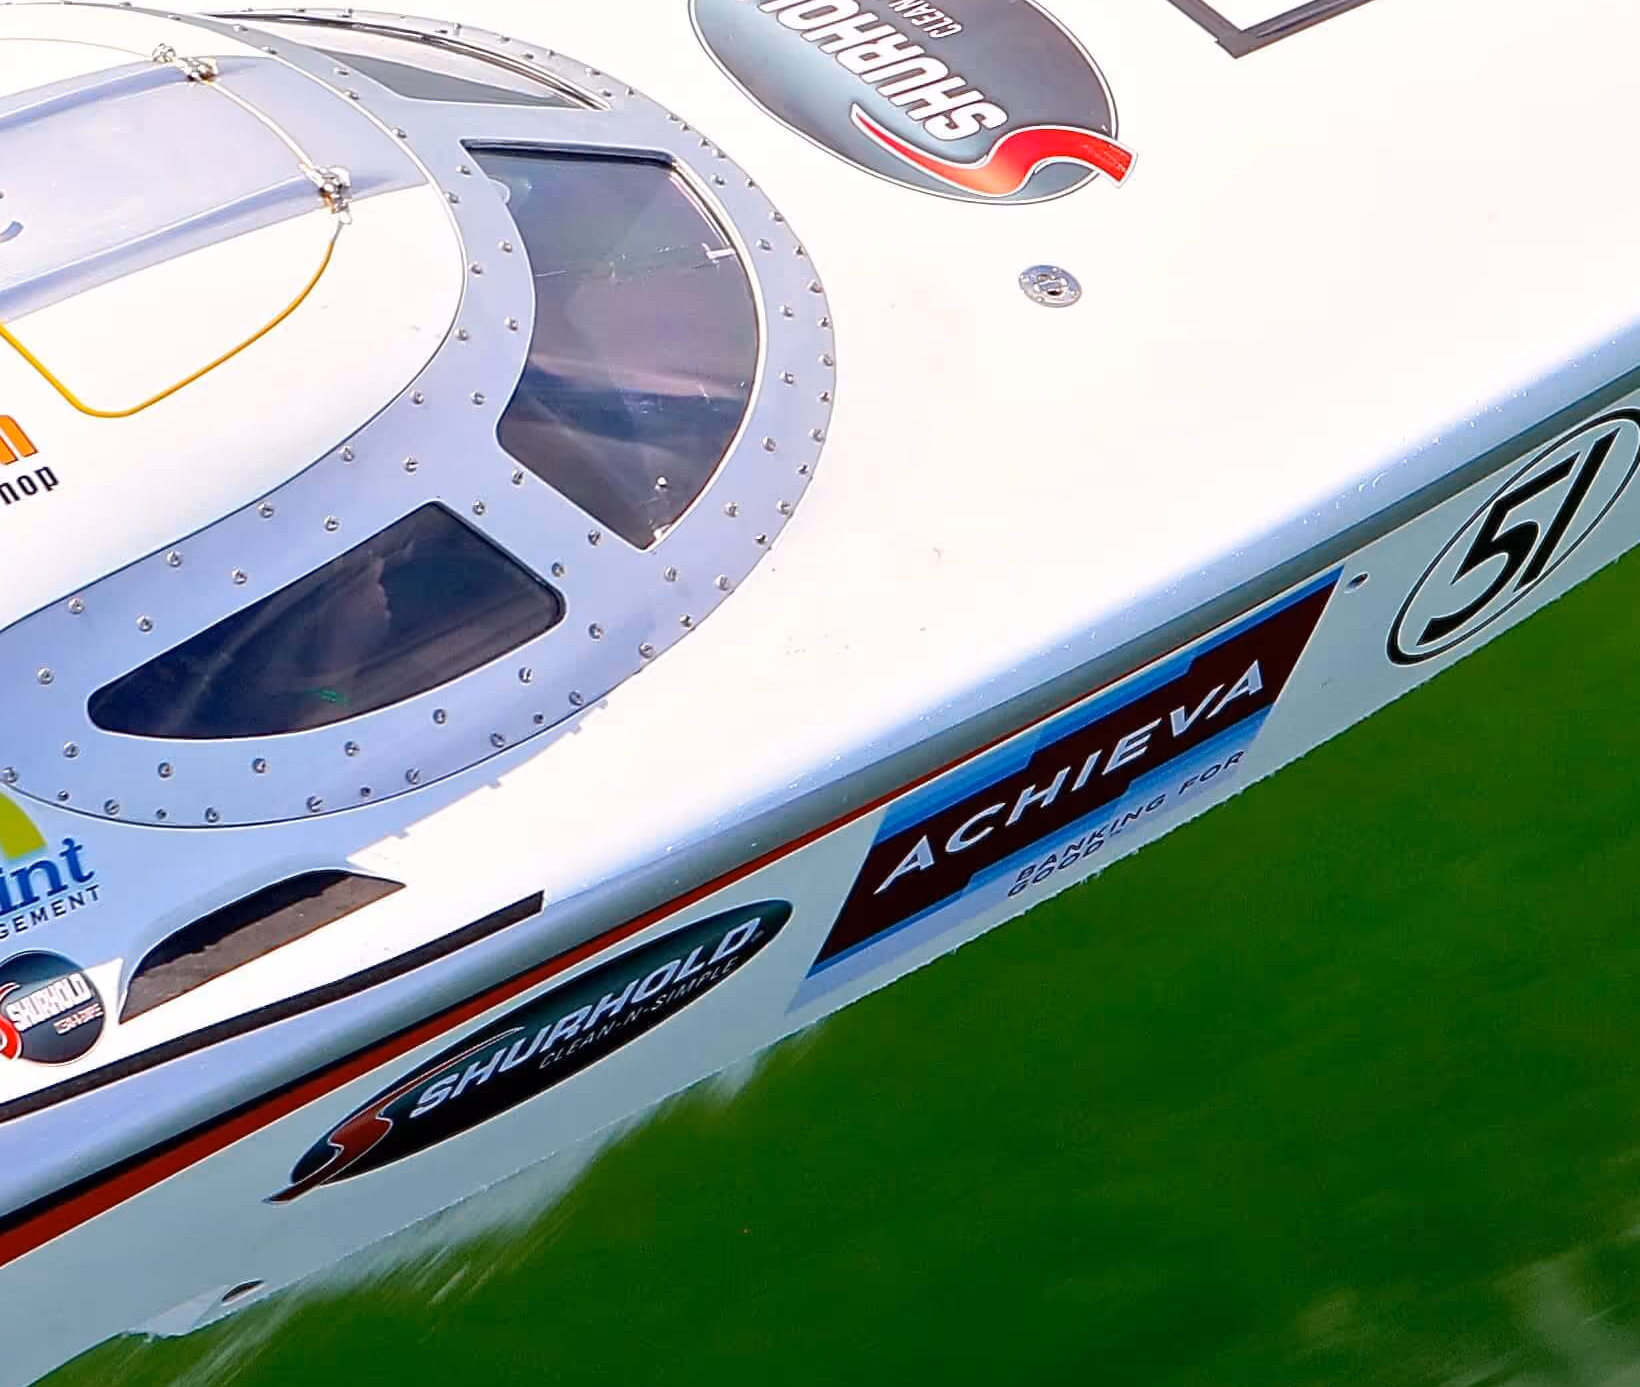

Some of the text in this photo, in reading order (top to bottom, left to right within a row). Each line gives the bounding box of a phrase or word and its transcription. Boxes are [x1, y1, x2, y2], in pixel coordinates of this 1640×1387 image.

[1415, 428, 1619, 651] 51
[873, 658, 1264, 894] ACHIEVA
[1016, 751, 1245, 882] BANKING FOR
[1007, 839, 1105, 897] GOOD
[408, 917, 765, 1119] SHURHOLD
[537, 956, 741, 1071] CLEAN-N-SIMPLE
